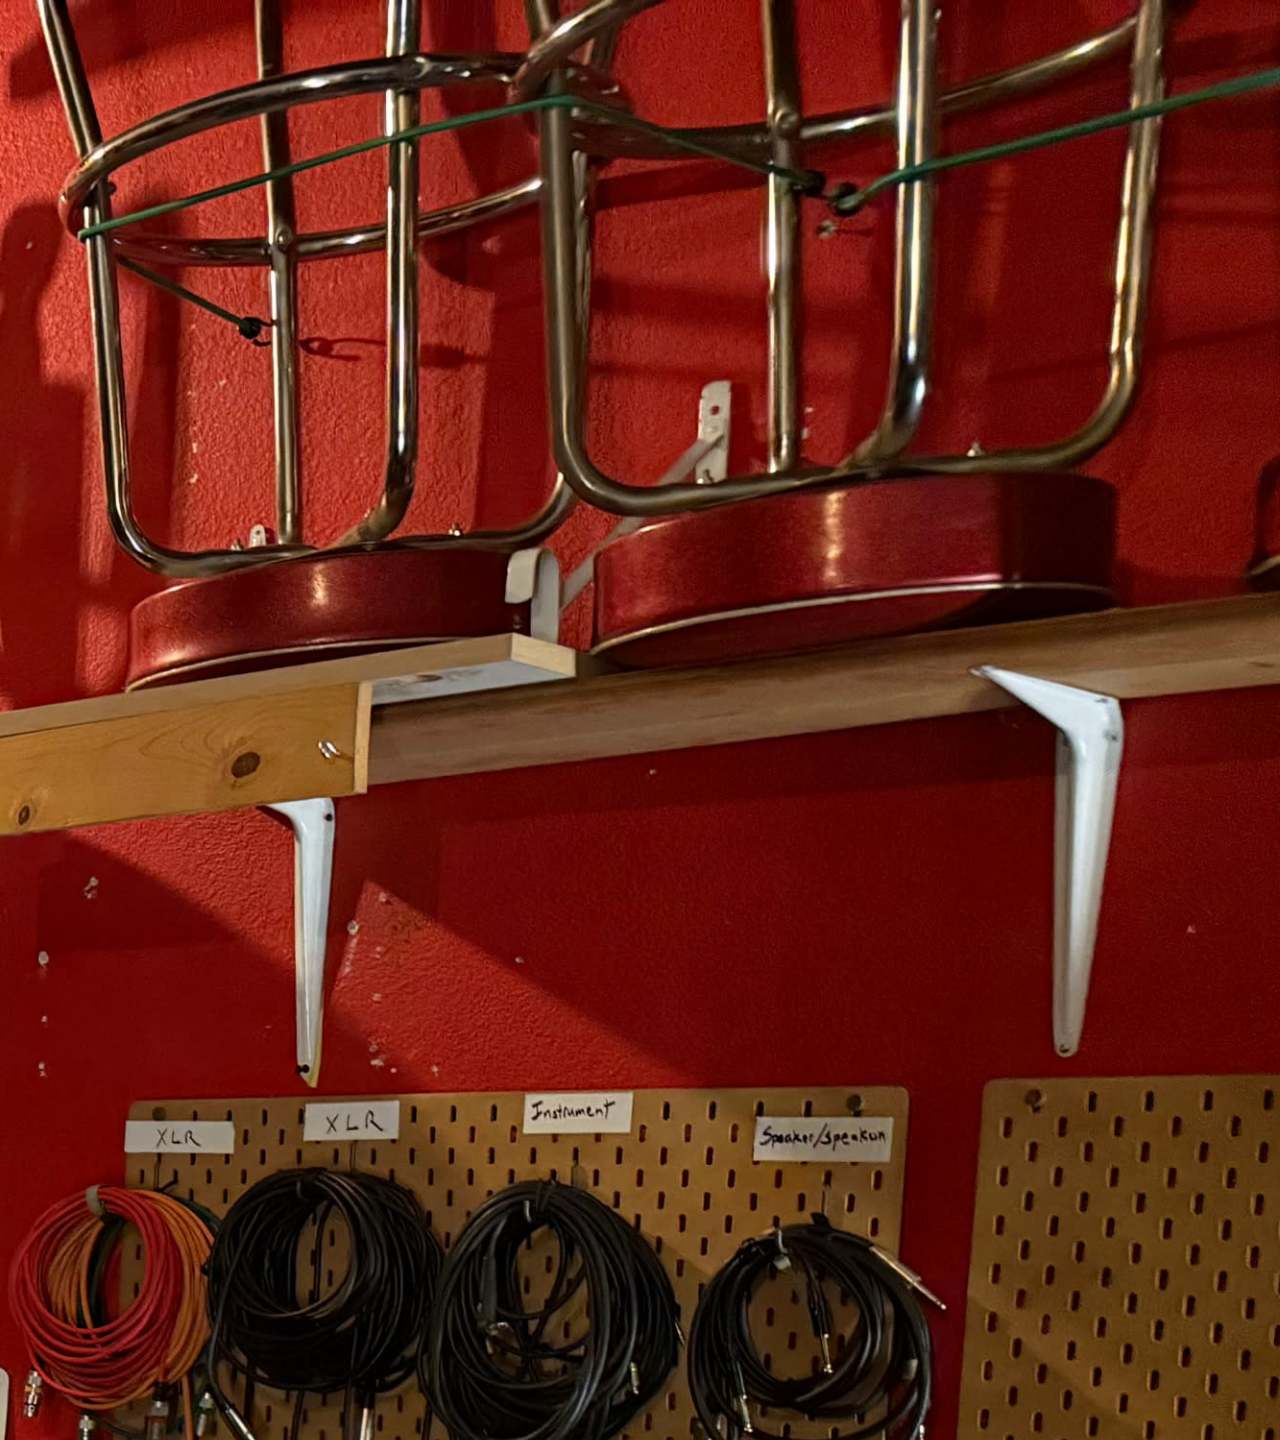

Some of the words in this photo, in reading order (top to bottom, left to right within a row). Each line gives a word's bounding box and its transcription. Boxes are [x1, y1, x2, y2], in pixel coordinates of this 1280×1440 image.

[531, 1097, 616, 1121] Instrument
[325, 1109, 384, 1135] XLR
[155, 1127, 202, 1148] XLR
